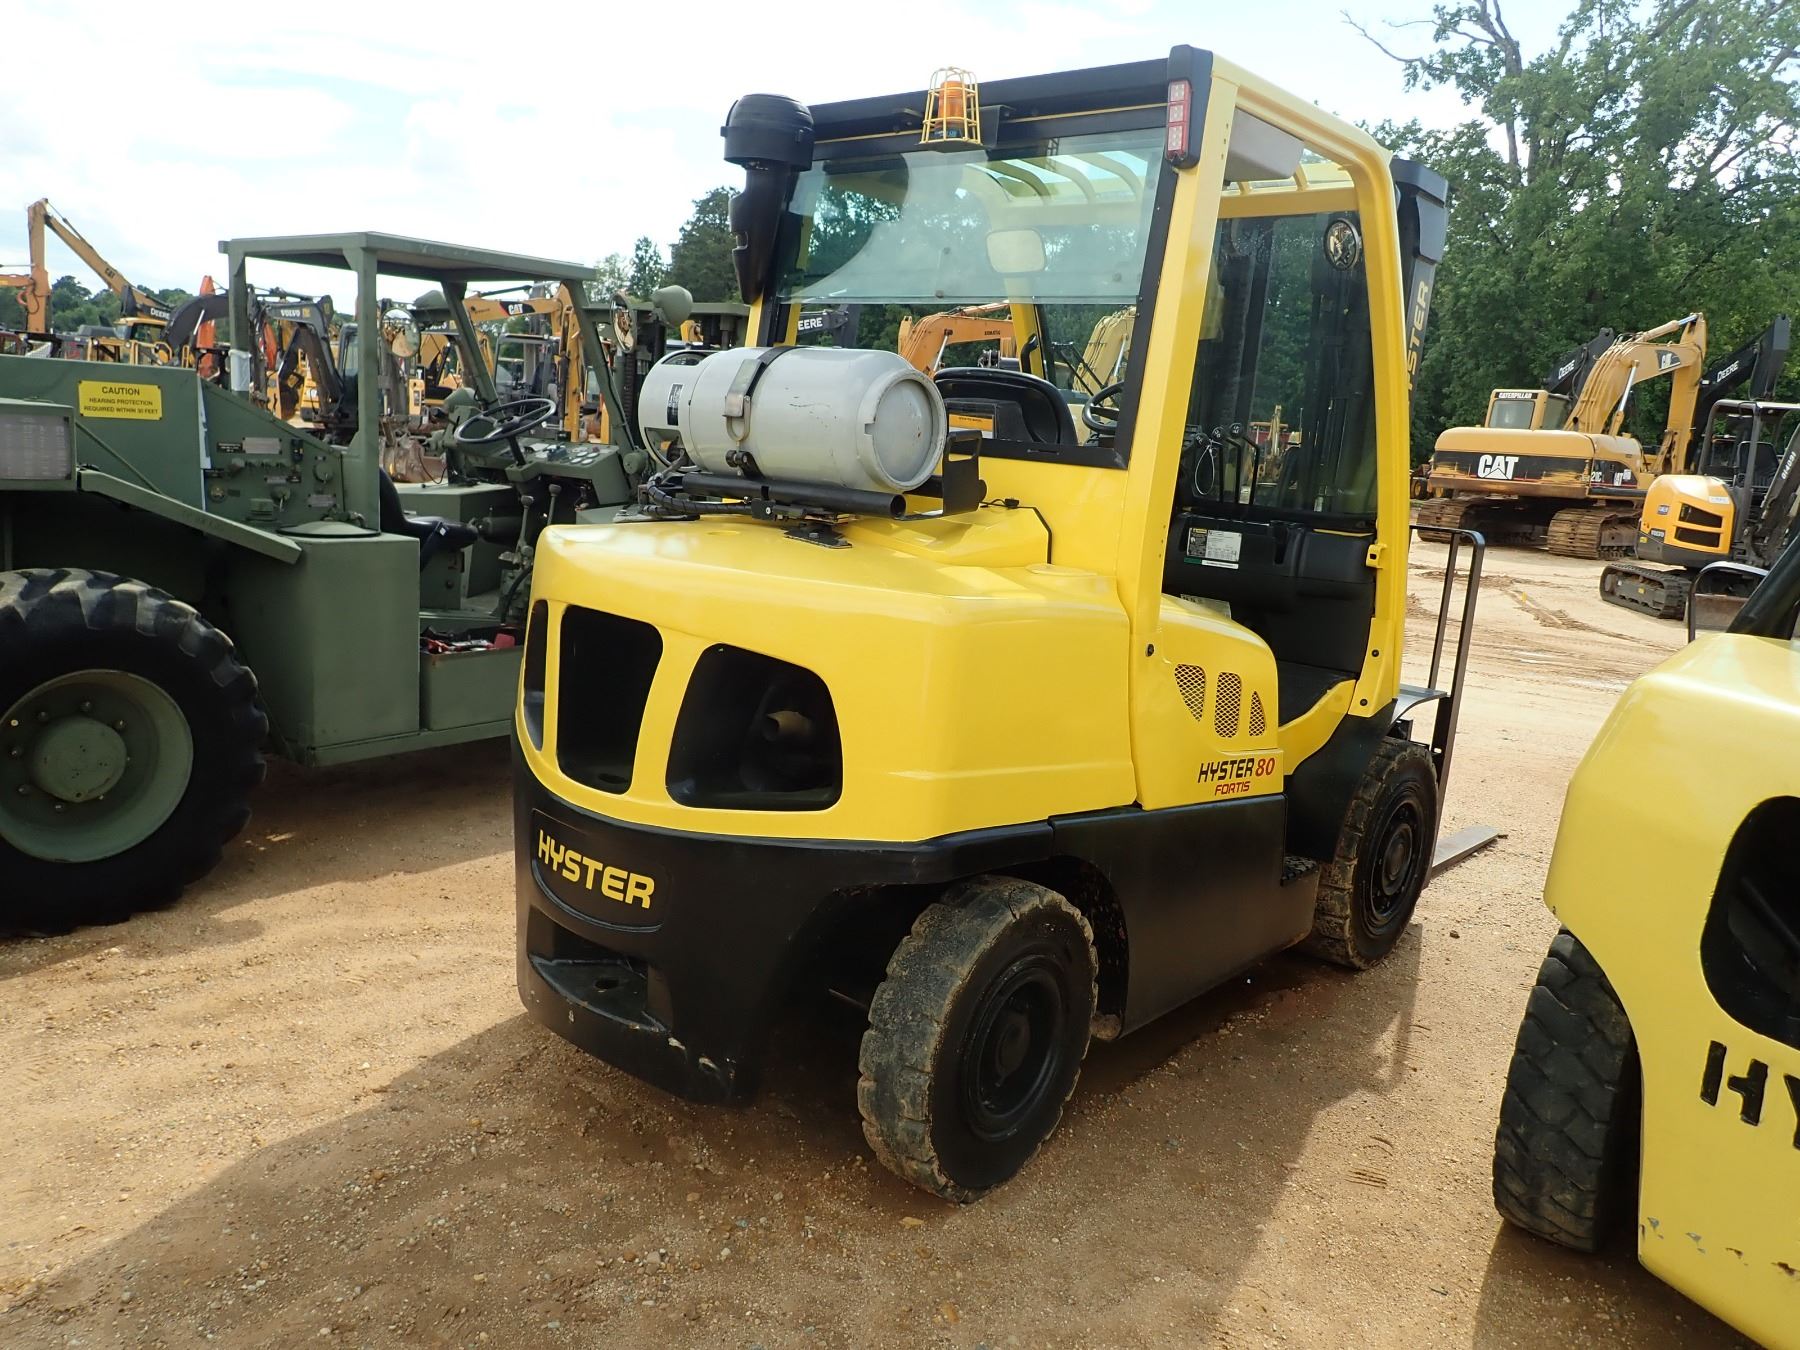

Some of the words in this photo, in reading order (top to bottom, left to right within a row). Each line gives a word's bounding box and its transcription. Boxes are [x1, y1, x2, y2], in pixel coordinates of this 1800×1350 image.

[280, 309, 300, 317] VOLVO
[508, 304, 523, 315] CAT
[1558, 360, 1575, 379] DEERE
[1716, 360, 1739, 382] DEERE
[102, 386, 140, 396] CAUTION
[1478, 454, 1519, 480] CAT
[1197, 758, 1254, 783] HYSTER
[1255, 757, 1276, 777] 80
[1214, 781, 1251, 796] FORTIS
[538, 829, 655, 909] HYSTER
